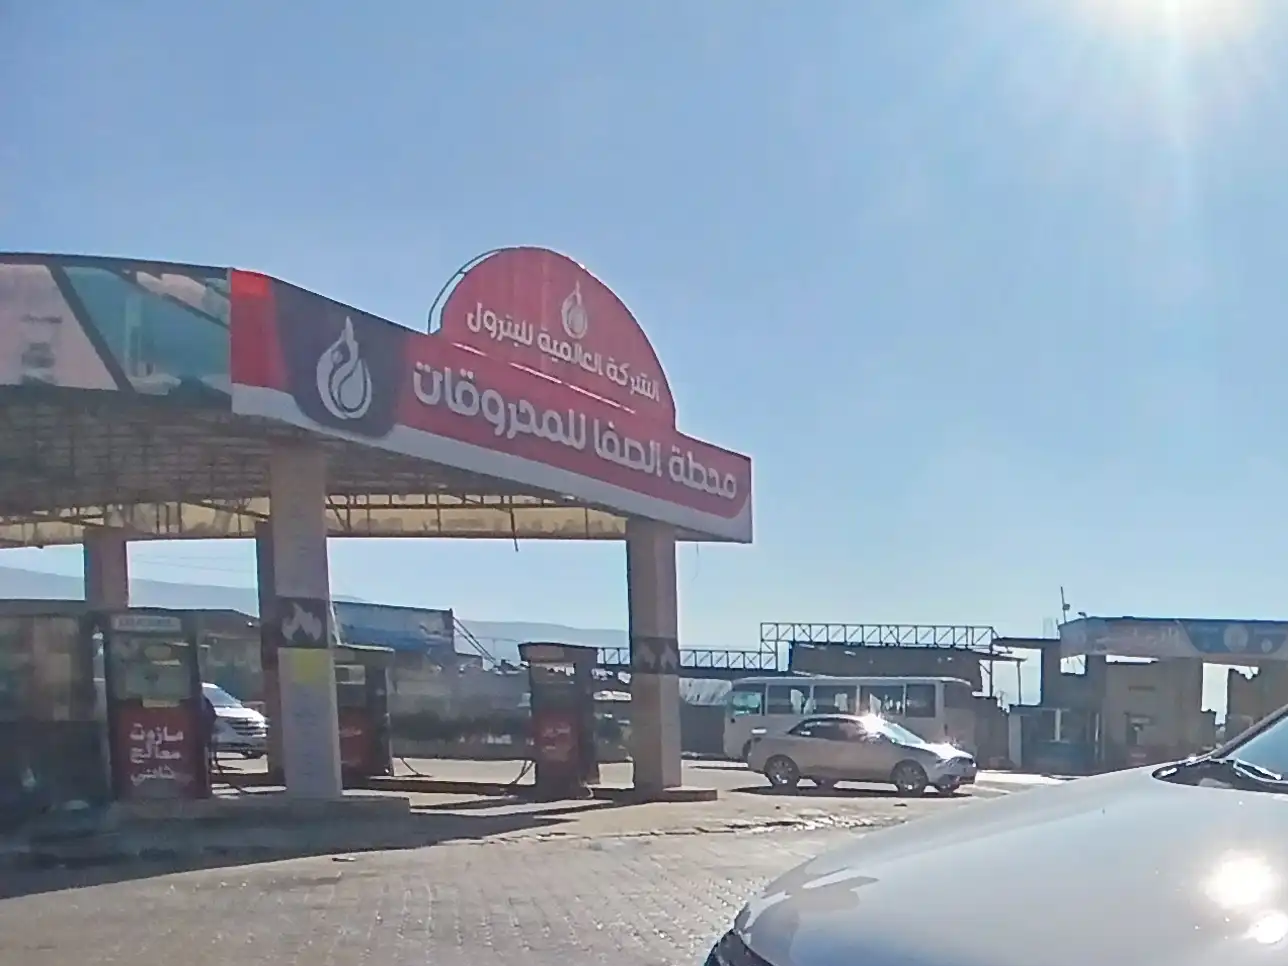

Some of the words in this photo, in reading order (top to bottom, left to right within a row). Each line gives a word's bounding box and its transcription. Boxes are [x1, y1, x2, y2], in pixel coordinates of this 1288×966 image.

[467, 302, 533, 346] للبترول
[537, 327, 603, 376] العالمية
[606, 358, 660, 402] الشركة
[413, 361, 587, 450] للمحروقات
[593, 419, 662, 477] الصفا
[668, 445, 737, 499] محطة
[129, 722, 184, 746] مازوت
[129, 746, 182, 765] معالج
